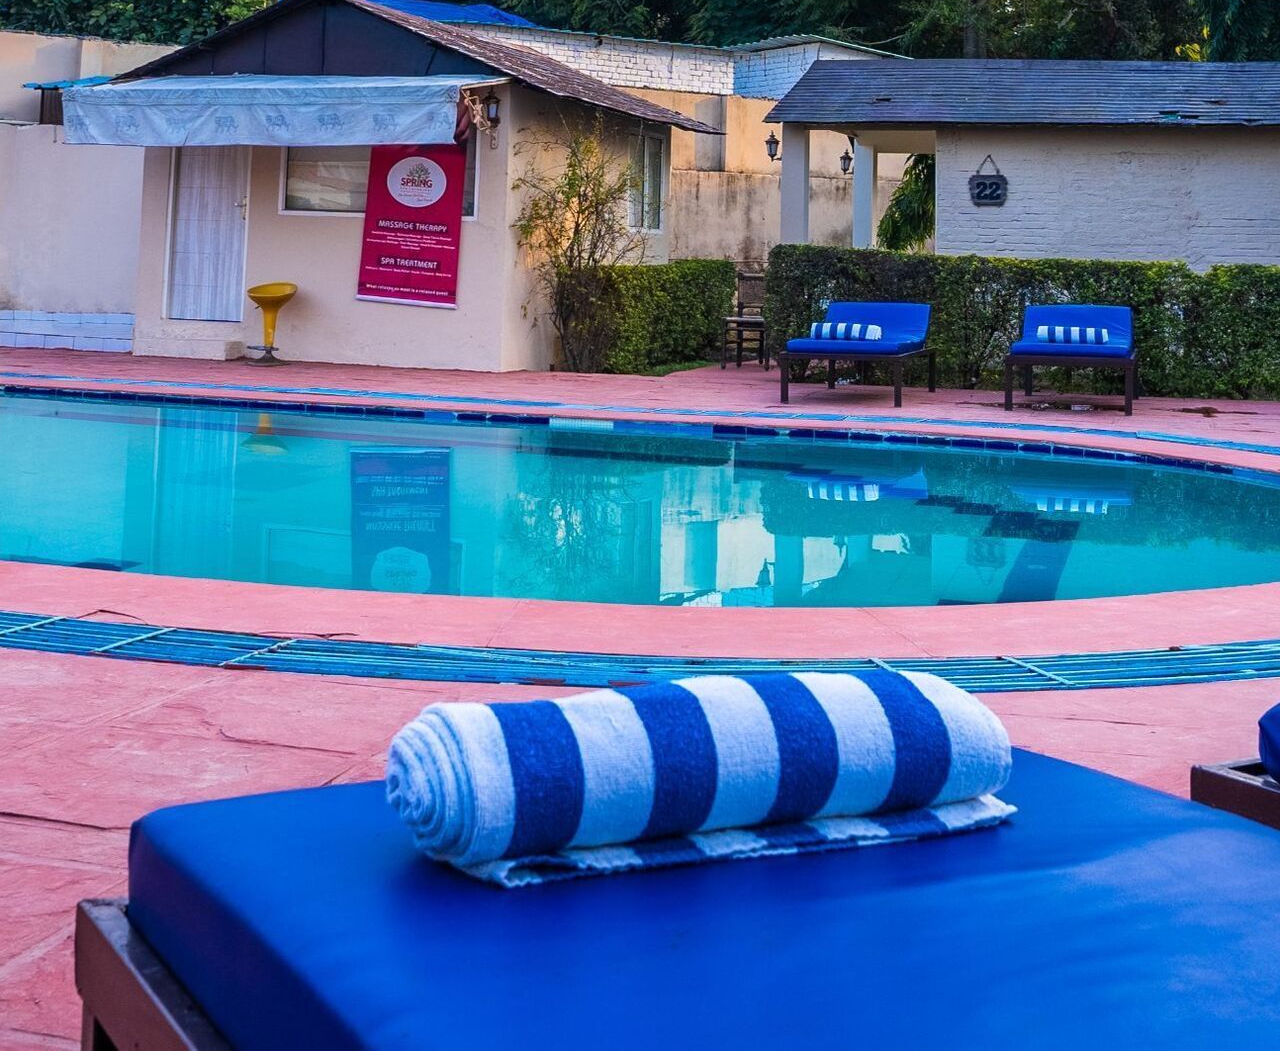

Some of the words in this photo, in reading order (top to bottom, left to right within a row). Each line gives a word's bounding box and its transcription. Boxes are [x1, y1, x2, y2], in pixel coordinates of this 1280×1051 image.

[401, 177, 433, 188] SPRING
[976, 181, 1001, 200] 22
[378, 220, 414, 230] MASSAGE
[415, 223, 448, 232] THERAPY
[380, 257, 395, 265] SPA
[396, 258, 438, 269] TREATMENT
